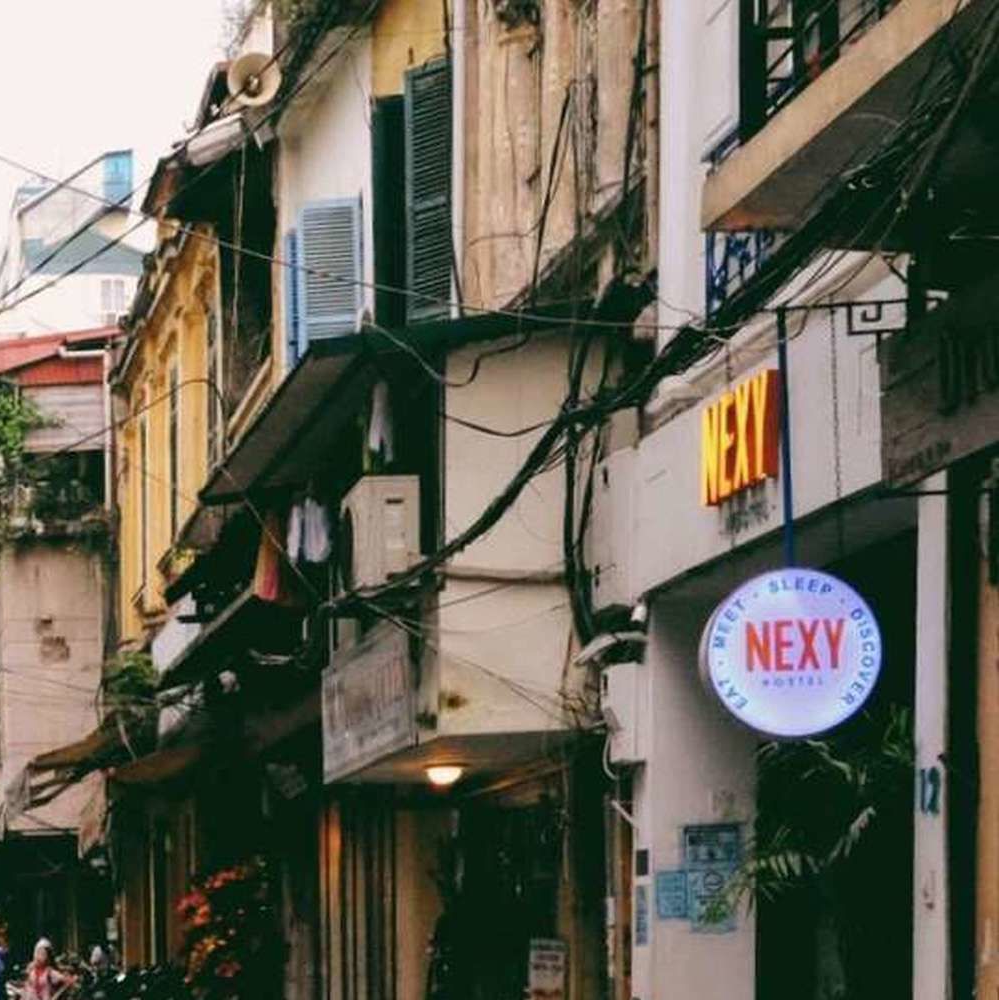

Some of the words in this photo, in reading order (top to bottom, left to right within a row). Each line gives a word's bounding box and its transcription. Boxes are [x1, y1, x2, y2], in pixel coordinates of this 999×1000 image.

[703, 369, 774, 506] NEXY
[768, 576, 833, 594] SLEEP
[712, 599, 747, 649] MEET
[745, 618, 845, 672] NEXY
[840, 607, 876, 706] DISCOVER
[717, 679, 748, 710] EAT
